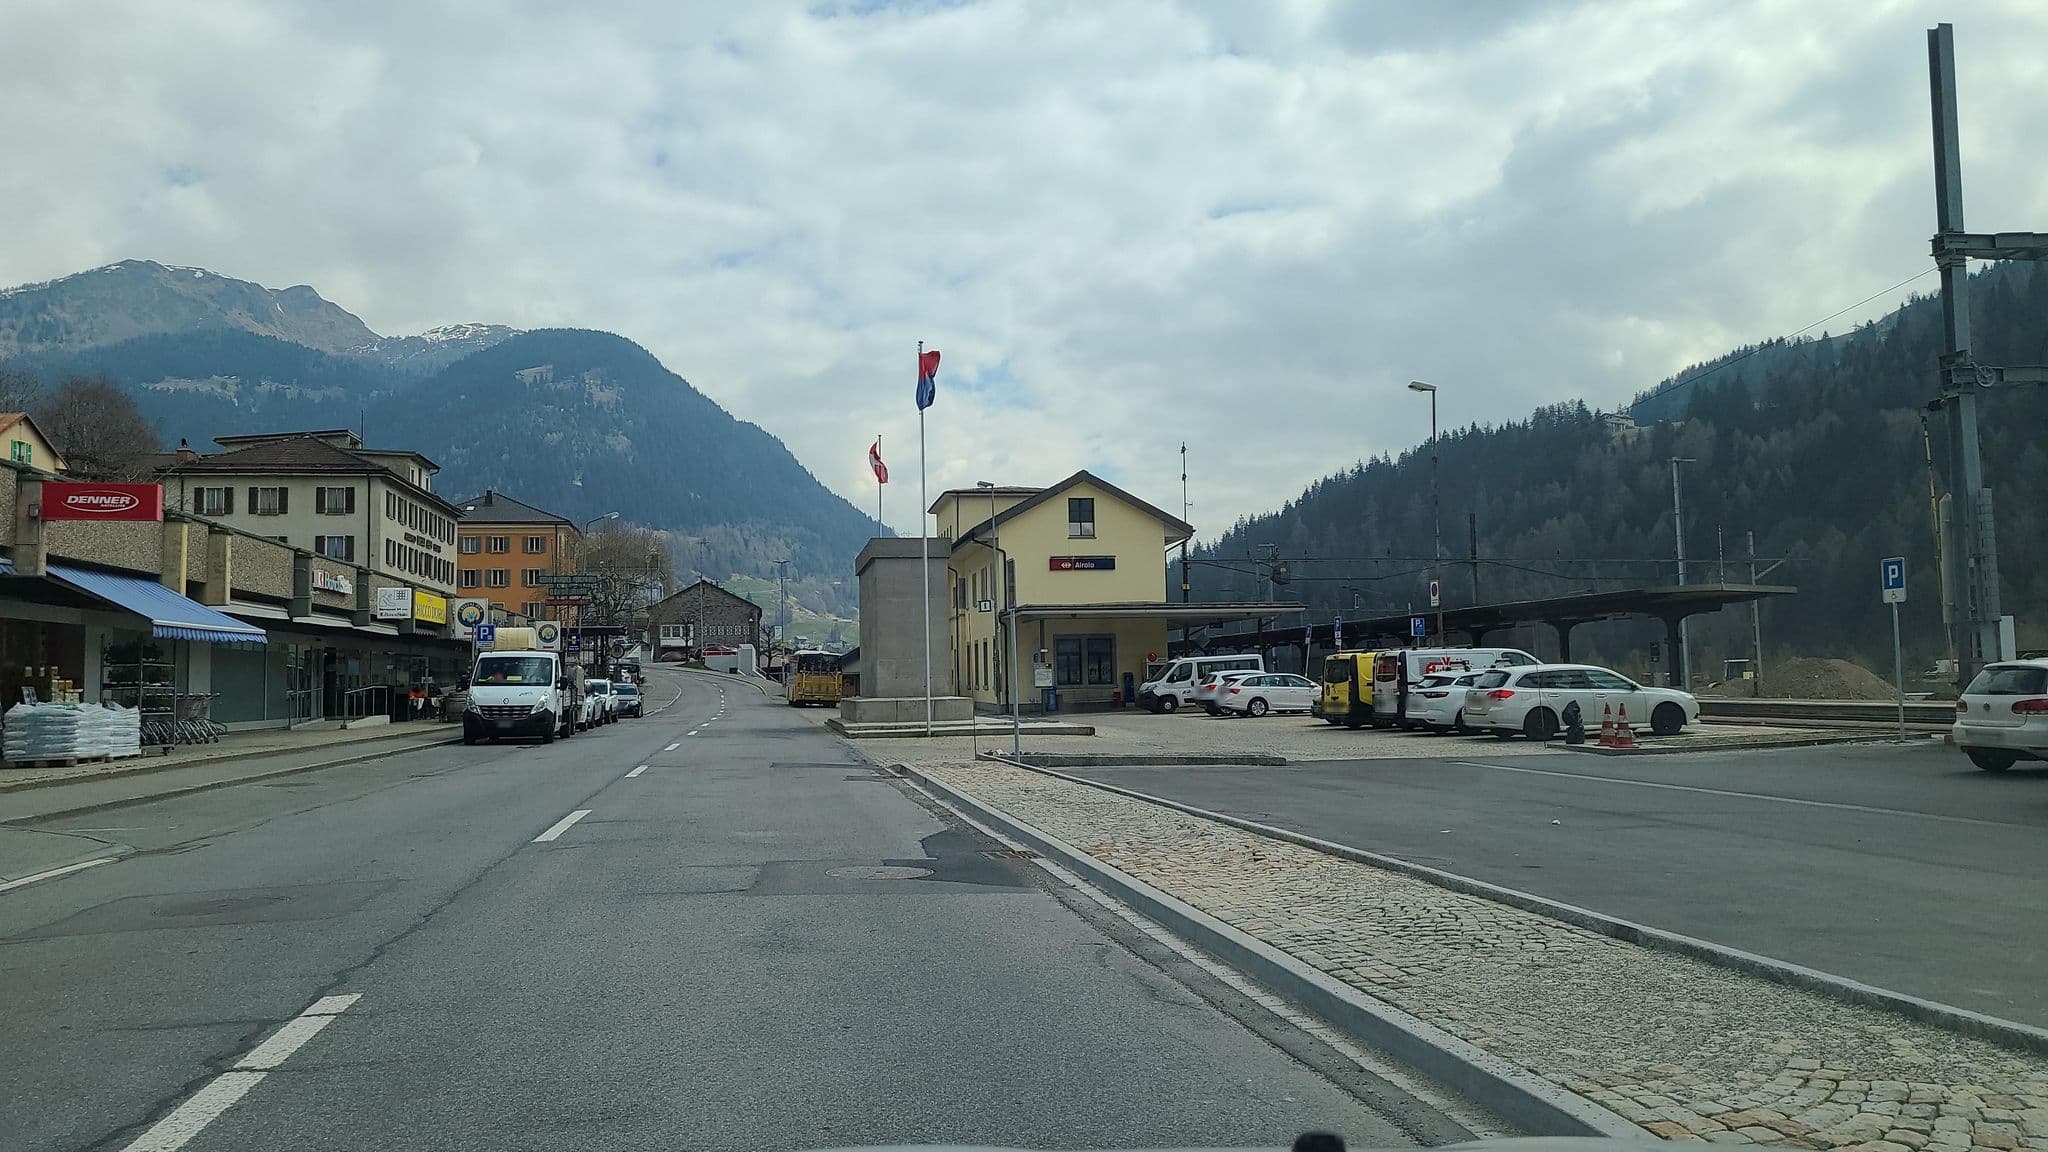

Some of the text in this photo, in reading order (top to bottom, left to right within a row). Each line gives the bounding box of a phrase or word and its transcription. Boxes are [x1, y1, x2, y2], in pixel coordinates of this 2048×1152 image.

[66, 495, 131, 504] DENNER
[1074, 561, 1095, 569] Airolo
[1888, 564, 1899, 586] P
[1415, 619, 1421, 628] P
[480, 627, 489, 640] P
